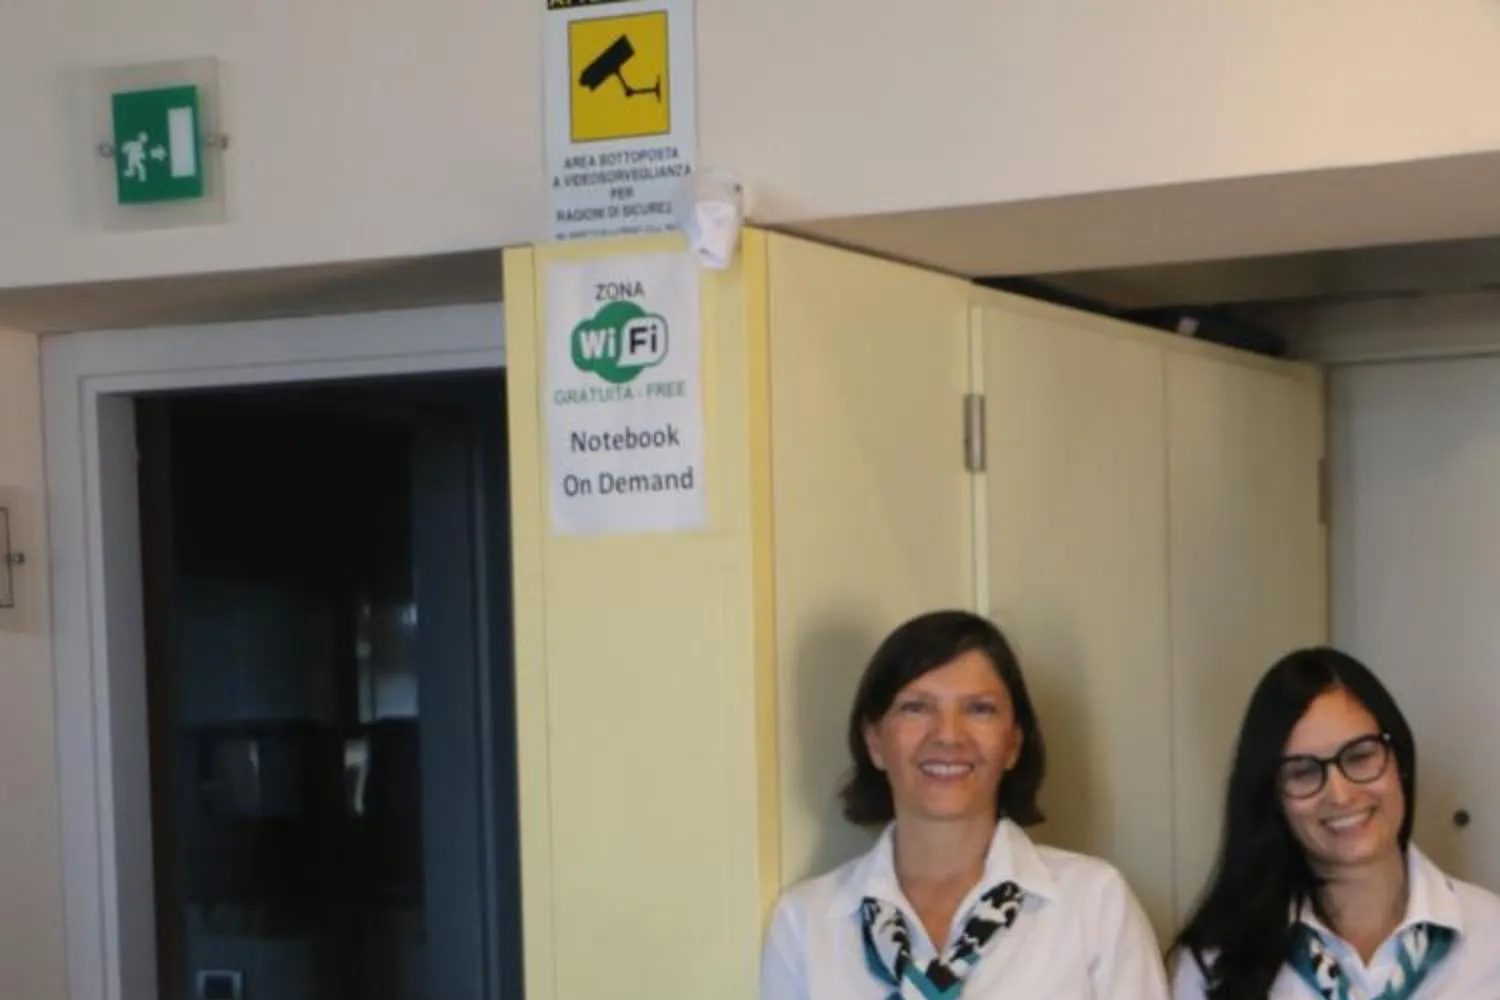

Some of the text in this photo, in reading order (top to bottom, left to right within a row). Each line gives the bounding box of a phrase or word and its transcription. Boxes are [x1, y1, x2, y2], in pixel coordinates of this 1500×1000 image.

[564, 147, 679, 170] AREA SOTTOPOSTA
[552, 163, 692, 188] A VIDEOSORVEGLIANZA
[610, 186, 634, 200] PER
[557, 206, 604, 221] RAGIONI
[607, 204, 620, 218] DI
[595, 281, 646, 301] ZONA
[553, 384, 633, 406] GRATUITA
[647, 380, 686, 399] FREE
[570, 424, 680, 453] Notebook
[563, 466, 694, 498] On Demand
